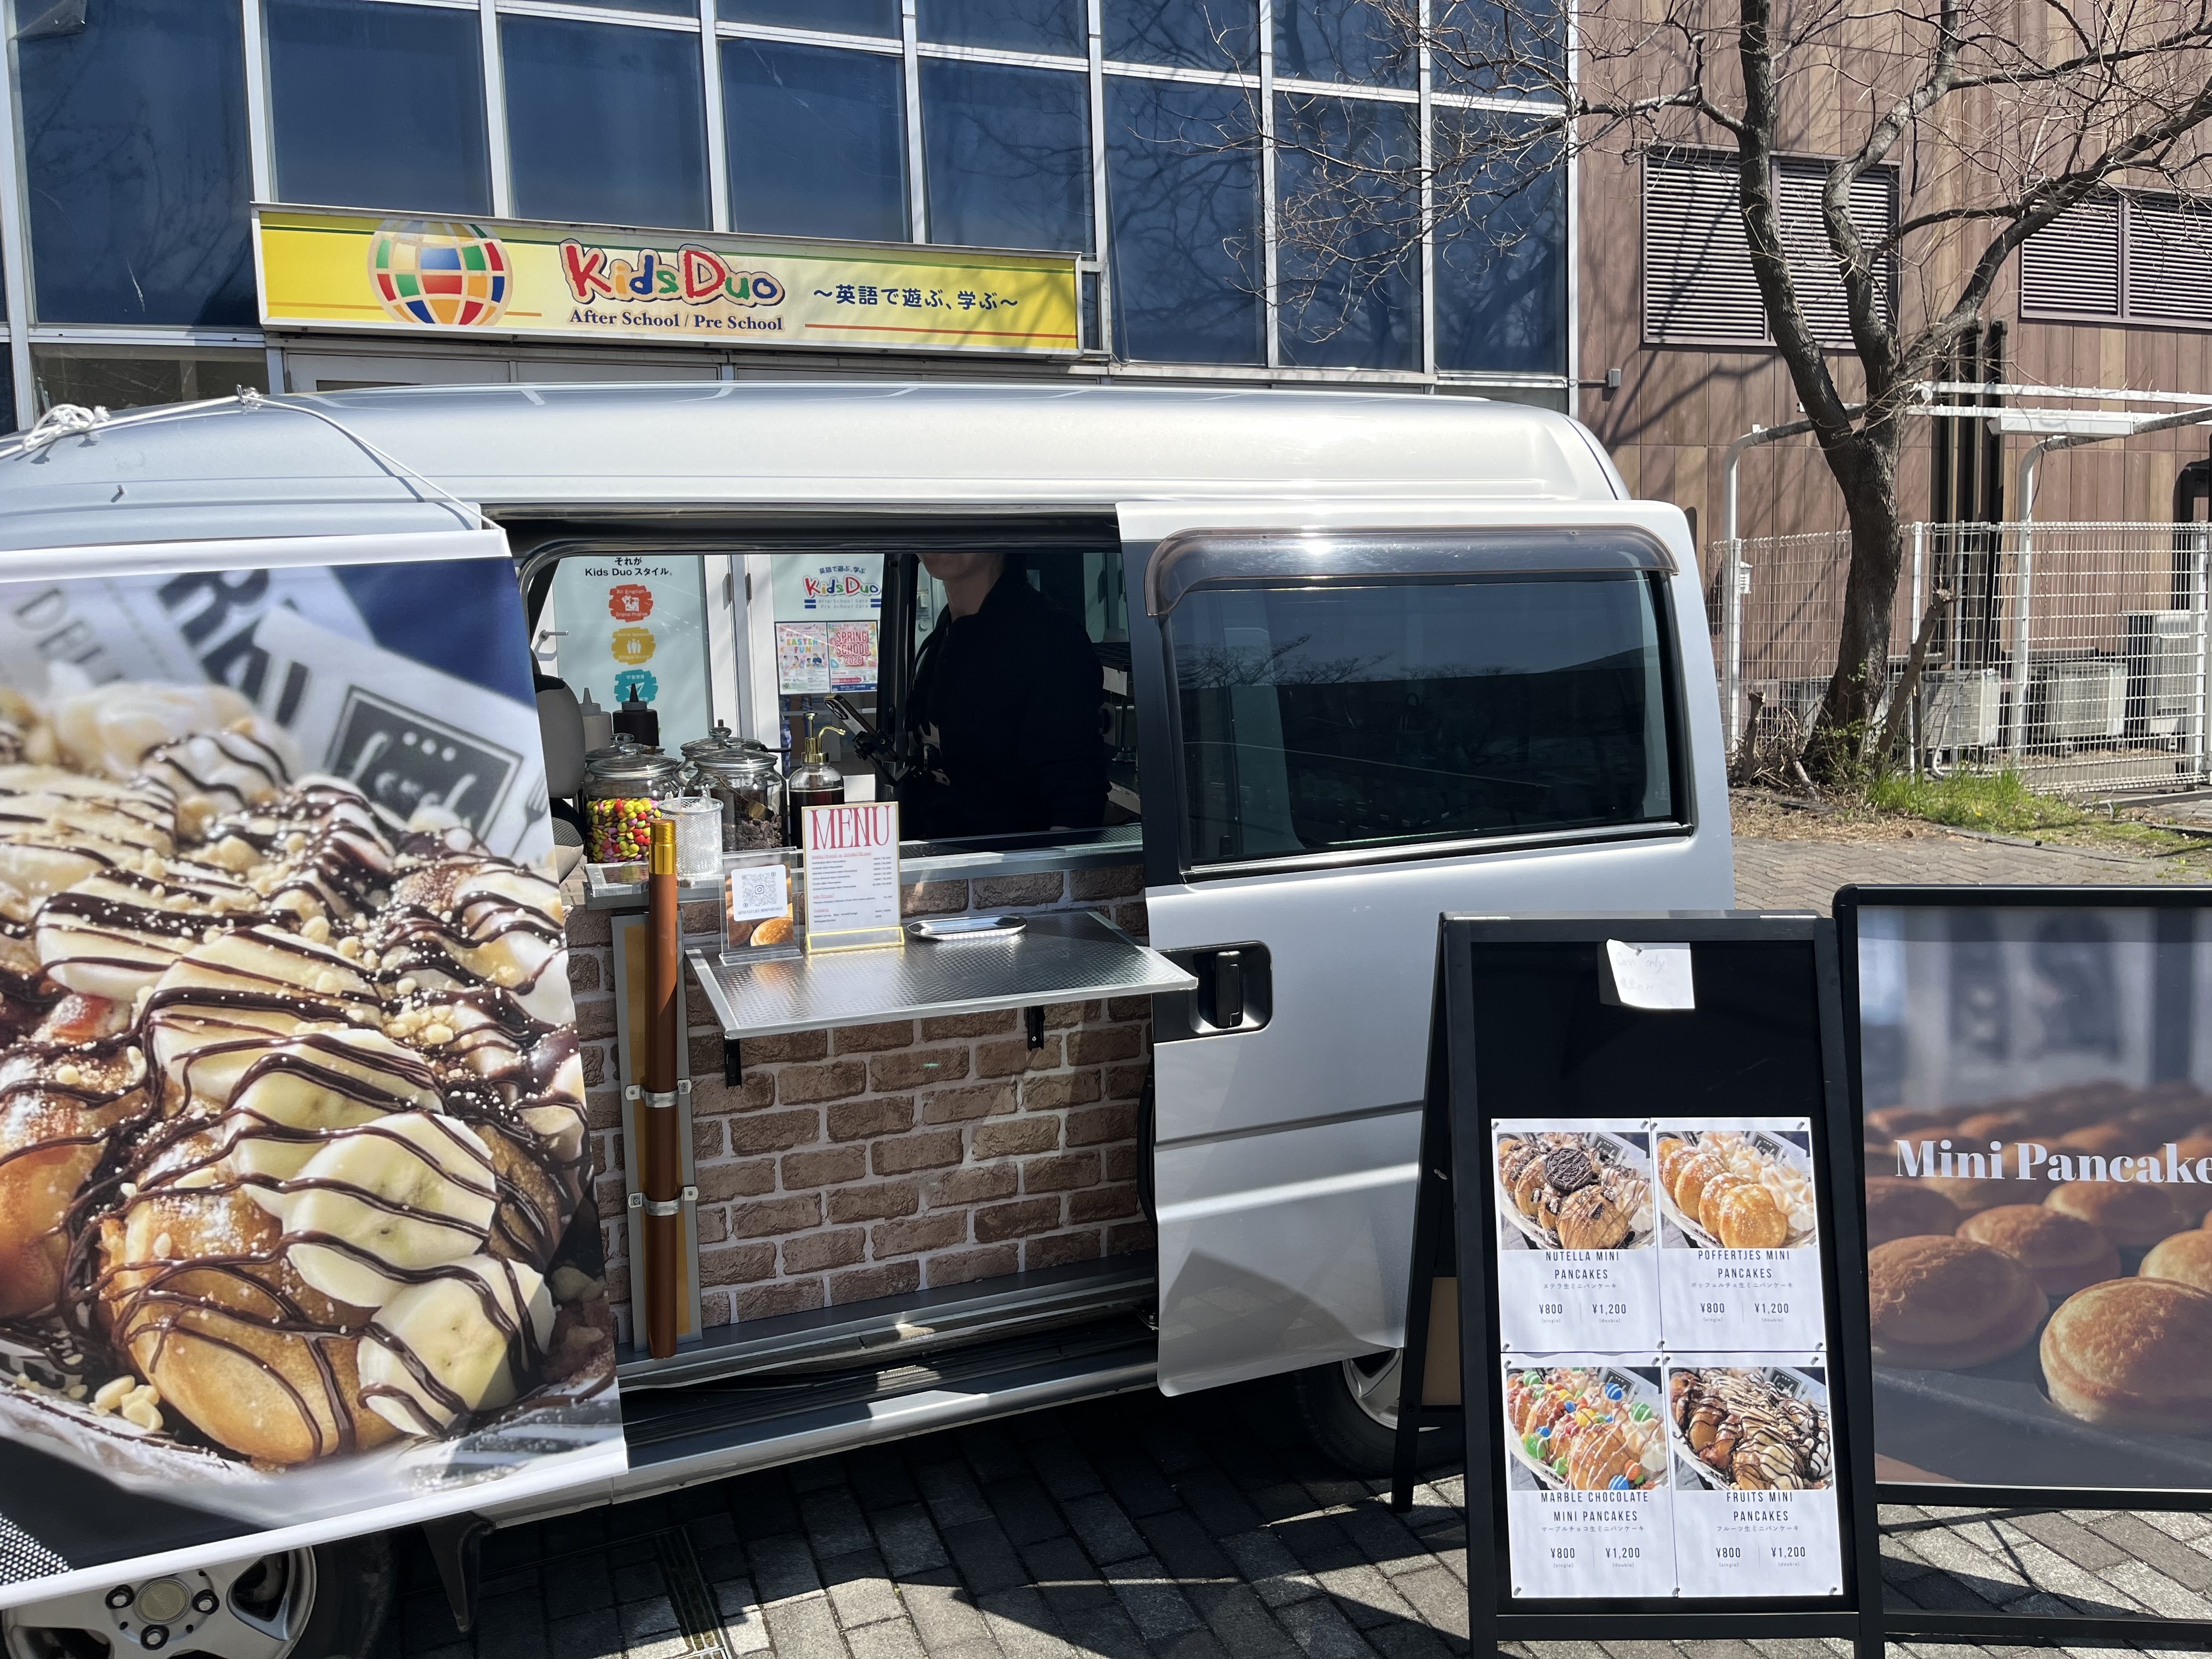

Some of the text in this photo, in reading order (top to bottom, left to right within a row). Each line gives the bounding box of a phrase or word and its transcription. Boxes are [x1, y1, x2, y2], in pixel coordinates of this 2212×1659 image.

[570, 309, 783, 330] After School / Pre School
[614, 557, 642, 566] それが
[836, 631, 869, 643] SPRING
[836, 644, 870, 656] SCHOOL
[845, 656, 863, 665] 2026
[810, 805, 890, 850] MENU
[1646, 955, 1666, 974] only
[1894, 1139, 2005, 1180] Mini
[1546, 1251, 1619, 1261] NUTELLA MINI
[1699, 1250, 1790, 1260] POFFERTJES MINI
[1555, 1269, 1608, 1279] PANCAKES
[1718, 1268, 1772, 1278] PANCAKES
[1539, 1304, 1626, 1315] ¥800 ¥1,200
[1700, 1303, 1789, 1314] ¥800 ¥1,200
[1541, 1492, 1649, 1503] MARBLE CHOCOLATE
[1726, 1492, 1792, 1502] FRUITS MINI
[1554, 1511, 1638, 1521] MINI PANCAKES
[1734, 1511, 1788, 1521] PANCAKES
[1550, 1547, 1640, 1559] ¥800 ¥1,200
[1716, 1547, 1805, 1559] ¥800 ¥1,200
